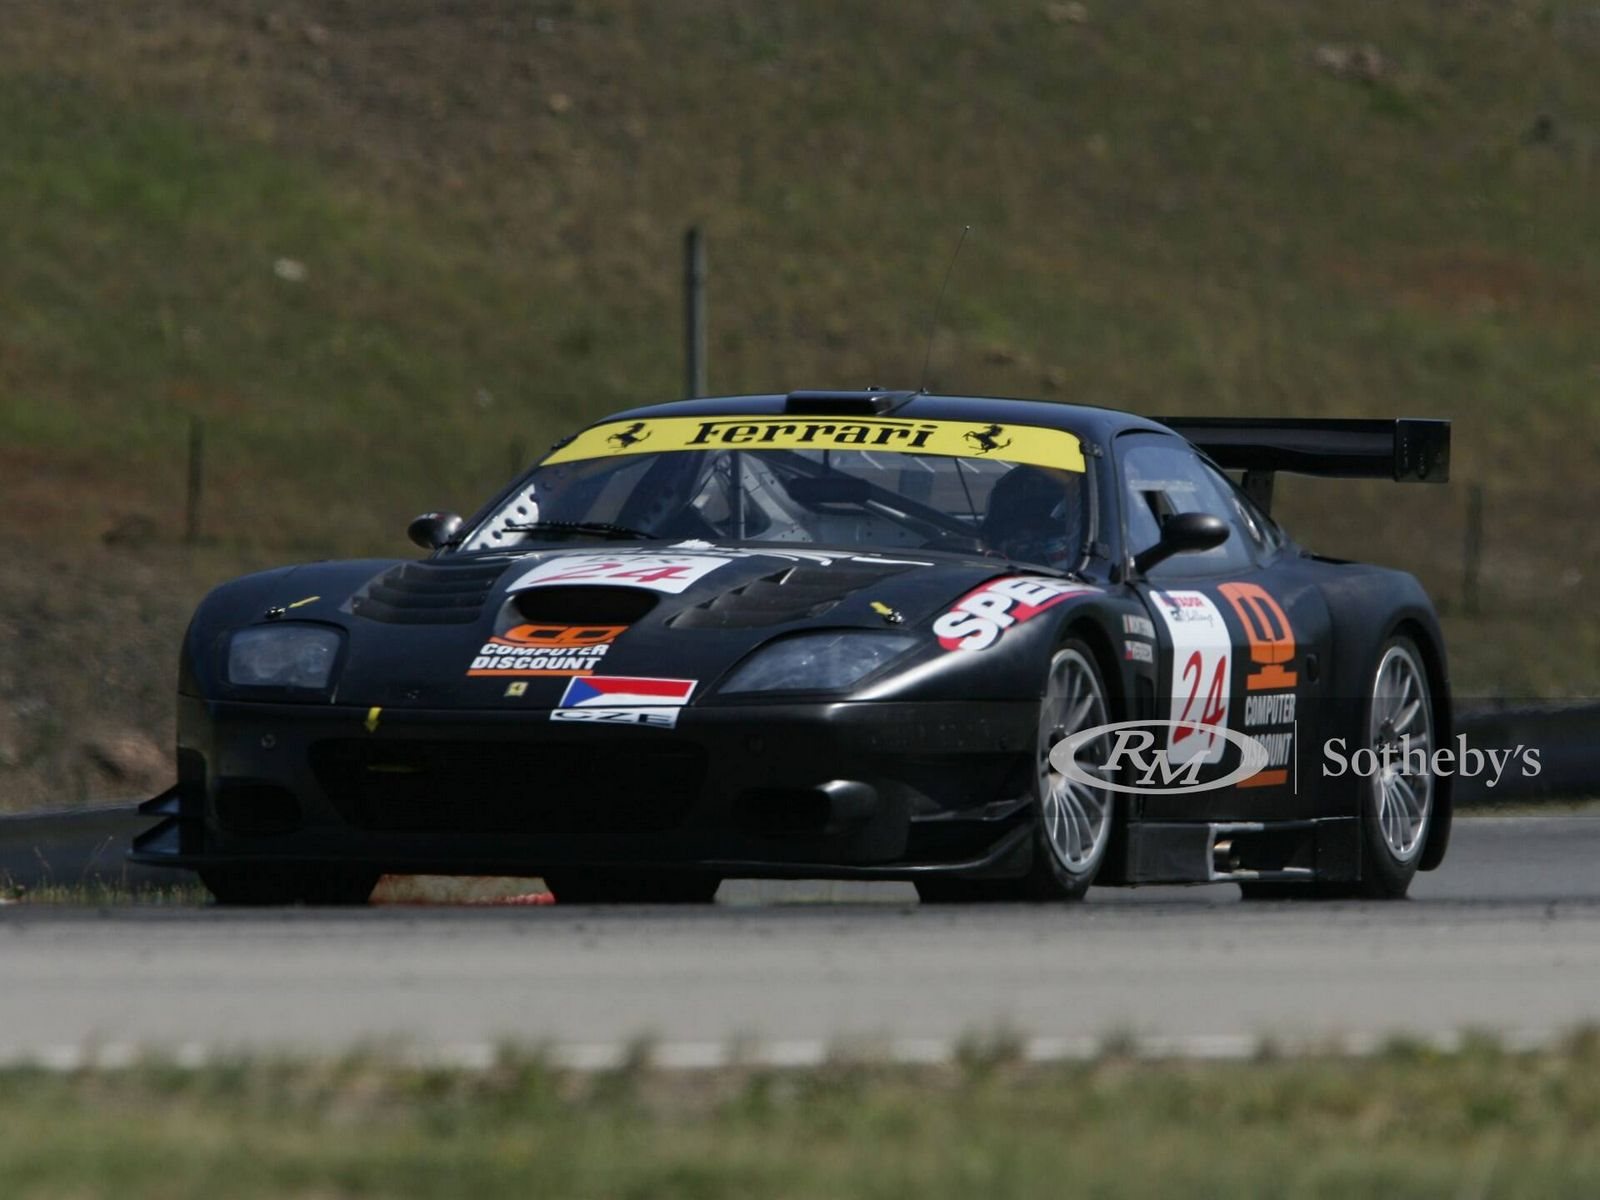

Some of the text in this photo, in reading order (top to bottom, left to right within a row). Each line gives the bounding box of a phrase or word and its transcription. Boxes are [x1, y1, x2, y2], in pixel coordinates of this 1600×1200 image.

[685, 419, 938, 448] Ferrari
[530, 563, 693, 582] 24
[480, 643, 610, 656] COMPUTER
[470, 656, 602, 669] DISCOUNT
[1173, 651, 1226, 748] 24
[553, 711, 676, 727] CZE
[1245, 693, 1296, 726] COMPUTER
